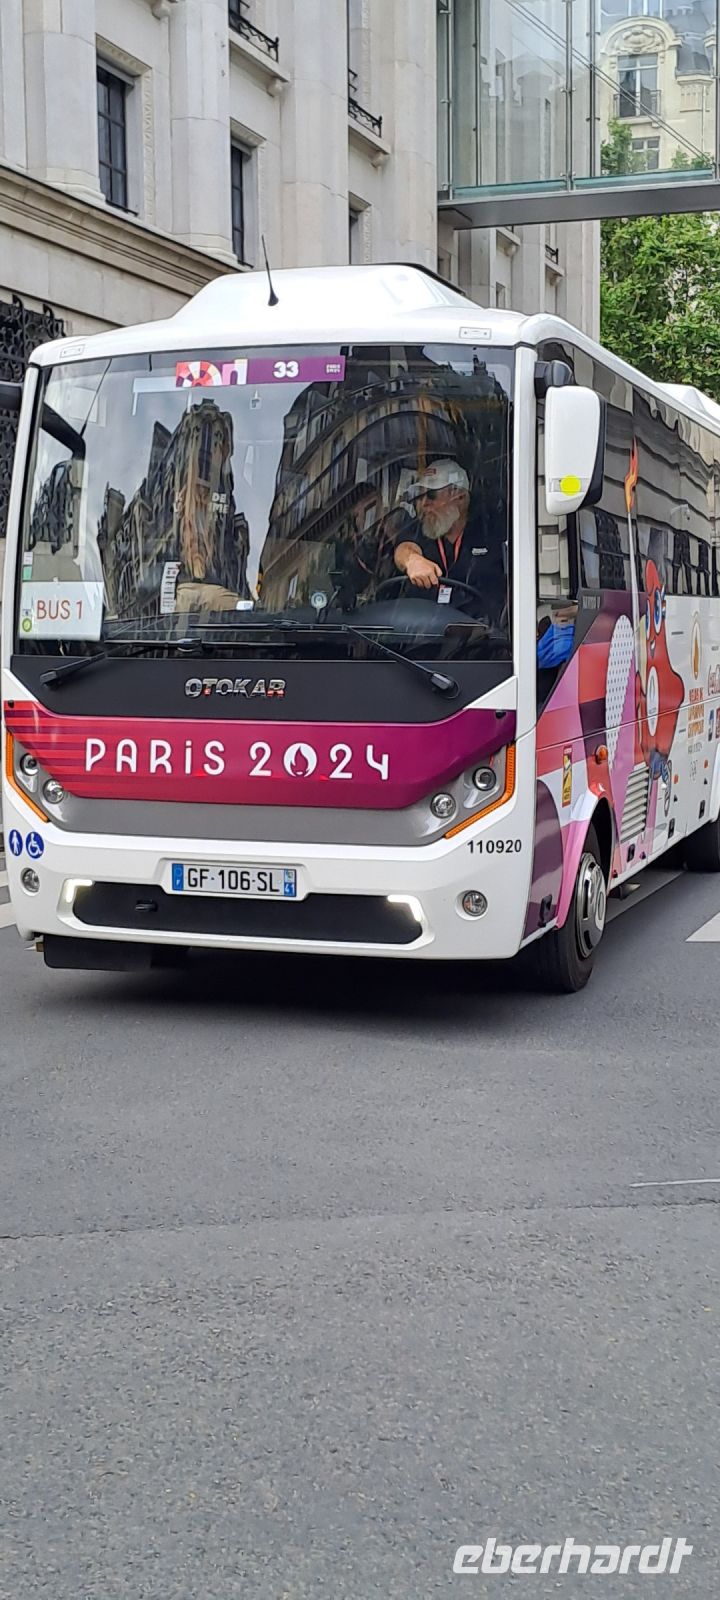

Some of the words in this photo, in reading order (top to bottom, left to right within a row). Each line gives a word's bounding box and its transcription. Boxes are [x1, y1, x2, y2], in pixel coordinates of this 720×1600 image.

[272, 361, 299, 378] 33
[36, 600, 70, 620] BUS
[76, 600, 83, 620] 1
[184, 677, 286, 698] OTOKAR
[248, 741, 389, 780] 2024
[467, 839, 522, 854] 110920
[187, 868, 280, 893] GF-106-SL
[284, 884, 295, 894] 41
